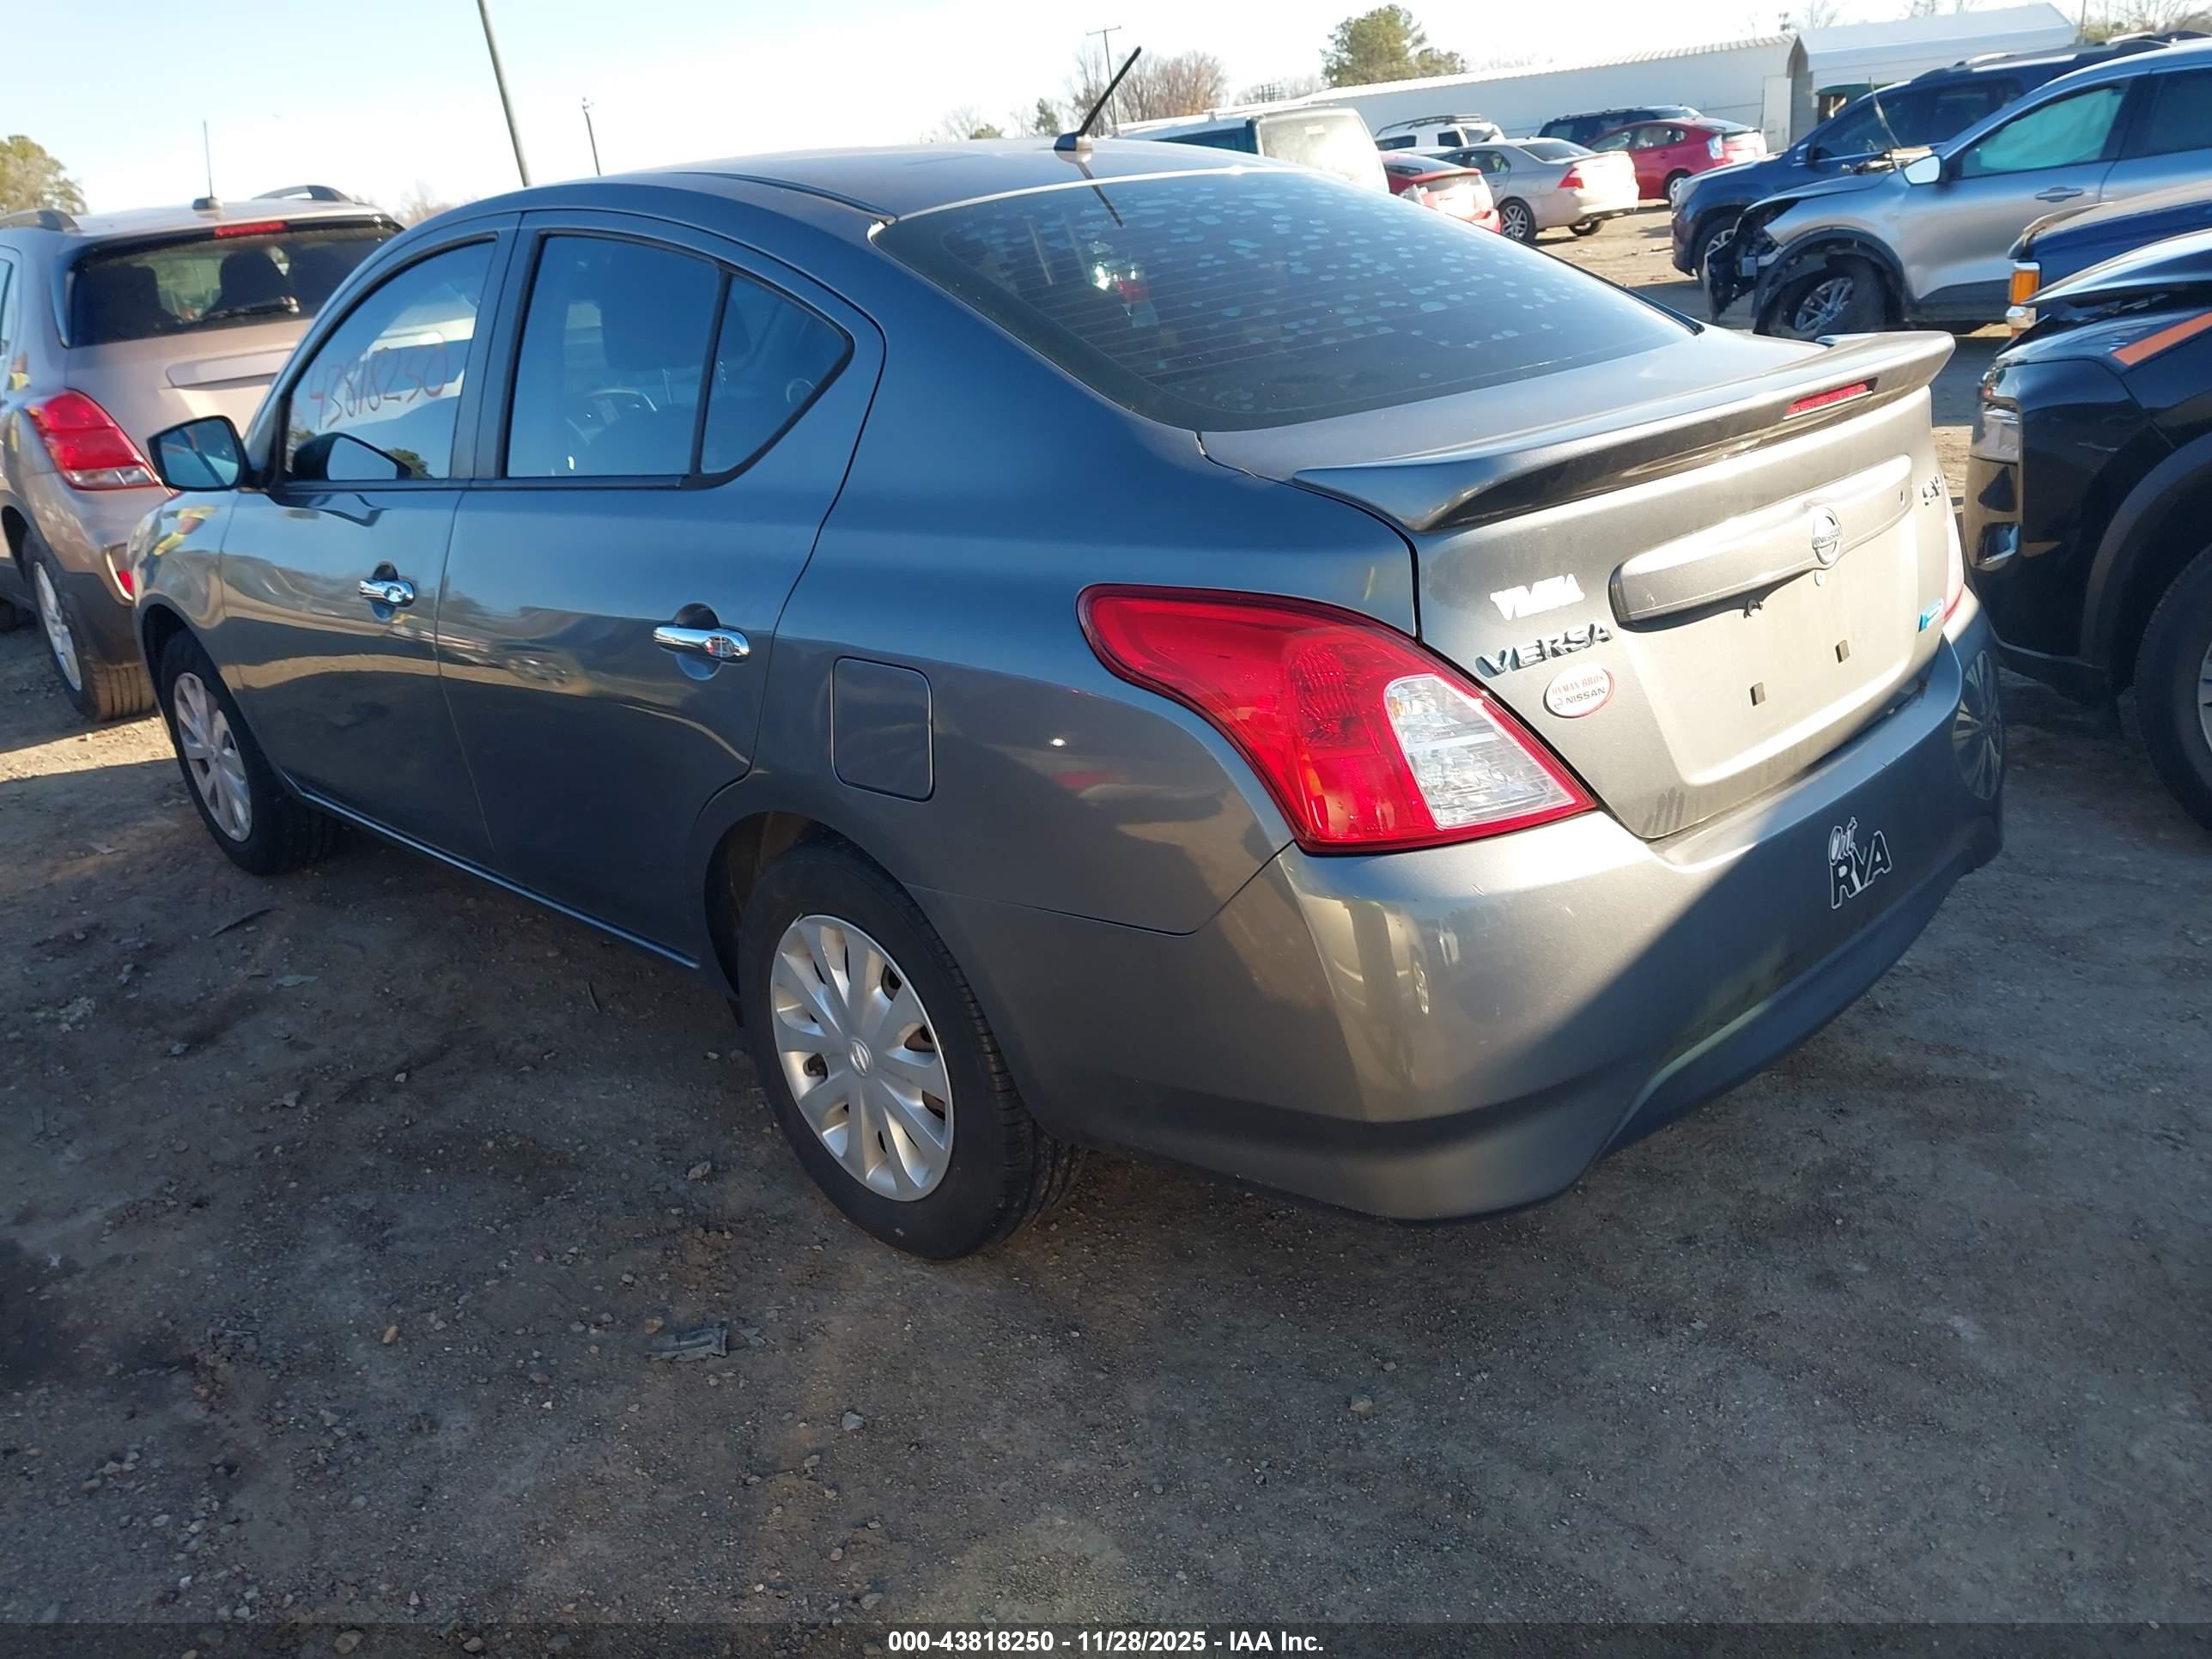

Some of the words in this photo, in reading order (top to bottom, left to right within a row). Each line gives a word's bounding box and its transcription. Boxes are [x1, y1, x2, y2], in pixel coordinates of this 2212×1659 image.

[308, 345, 448, 429] 43818250
[1475, 622, 1613, 678] VERSA
[1565, 686, 1606, 704] NISSAN
[1829, 830, 1893, 909] RVA
